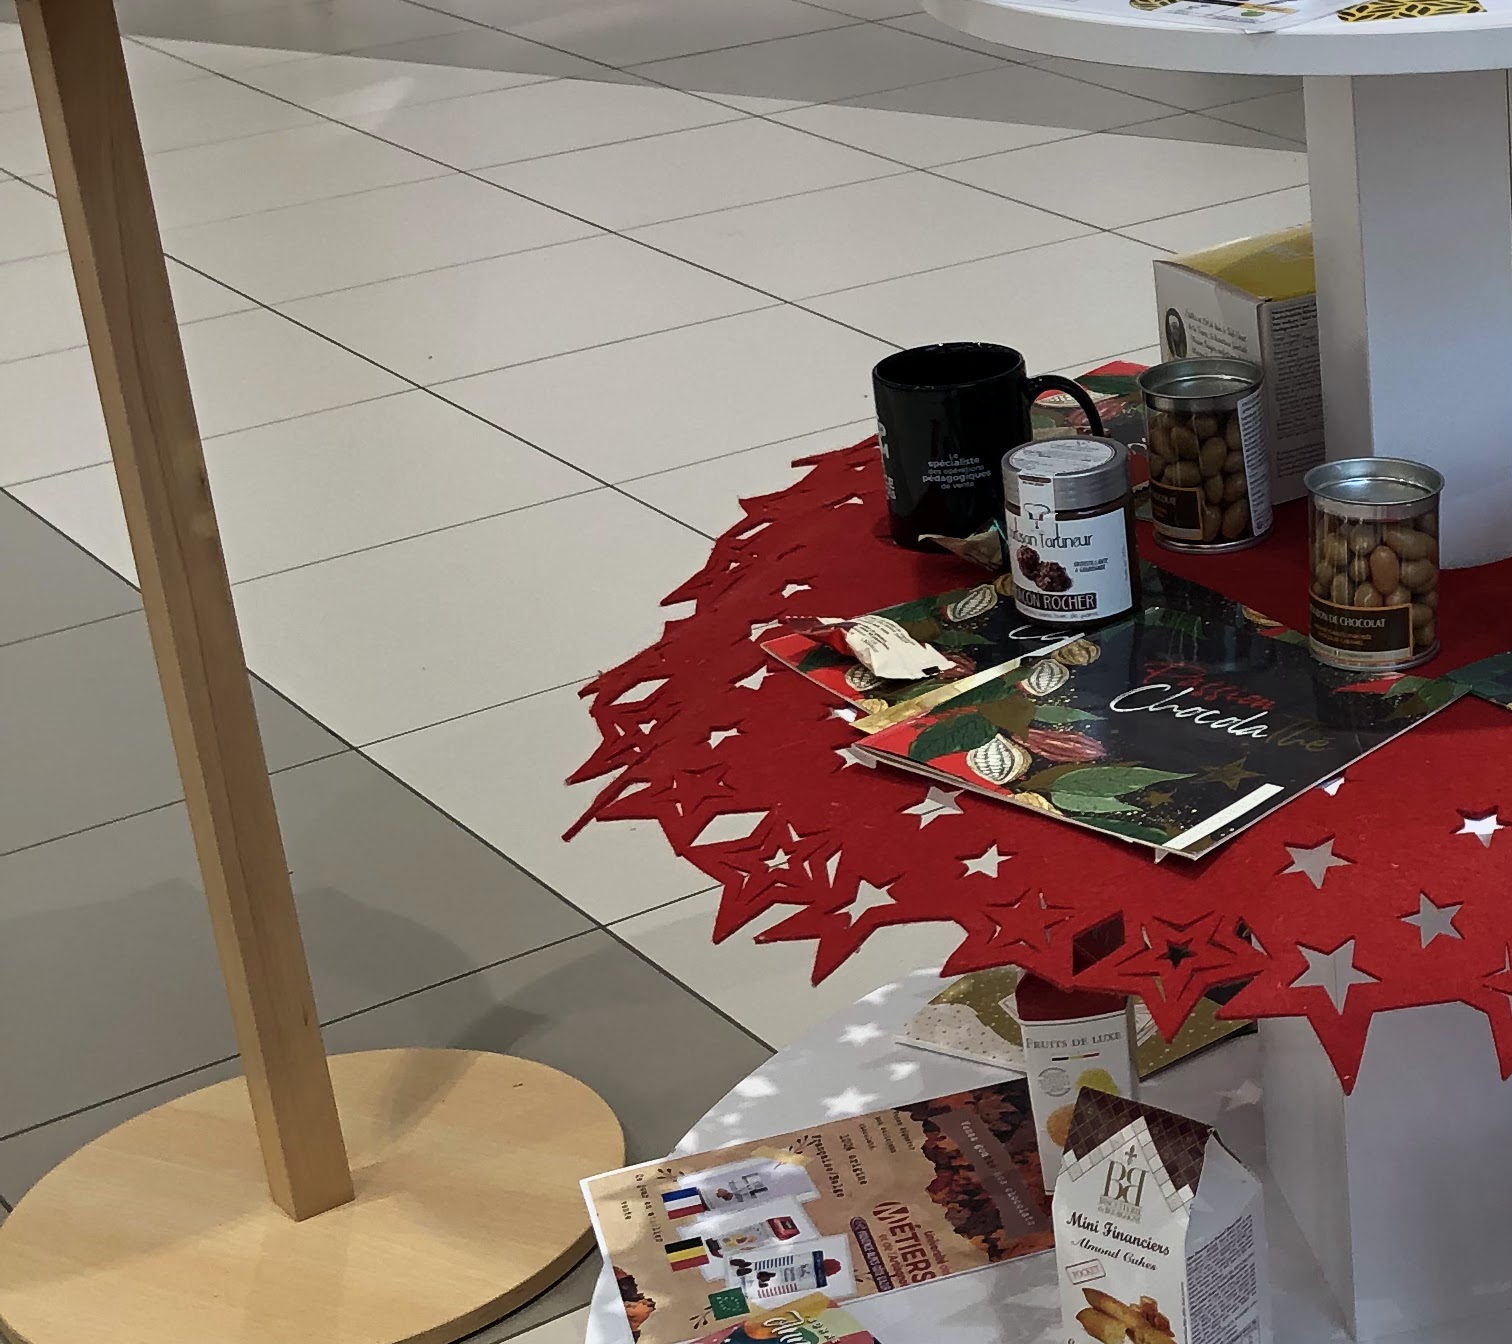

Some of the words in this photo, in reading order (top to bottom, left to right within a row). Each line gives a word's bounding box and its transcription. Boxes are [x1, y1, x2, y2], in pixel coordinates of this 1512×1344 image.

[1039, 521, 1094, 548] Tartineur
[1043, 593, 1096, 610] ROCHER
[1339, 617, 1386, 628] CHOCOLAT
[1026, 1037, 1068, 1049] FRUITS
[1071, 1037, 1088, 1047] DE
[1092, 1032, 1121, 1044] LUXE
[872, 1201, 937, 1284] MÉTIERS
[1066, 1211, 1099, 1233] Mini
[1102, 1222, 1170, 1255] Financiers
[1071, 1237, 1121, 1259] Almond
